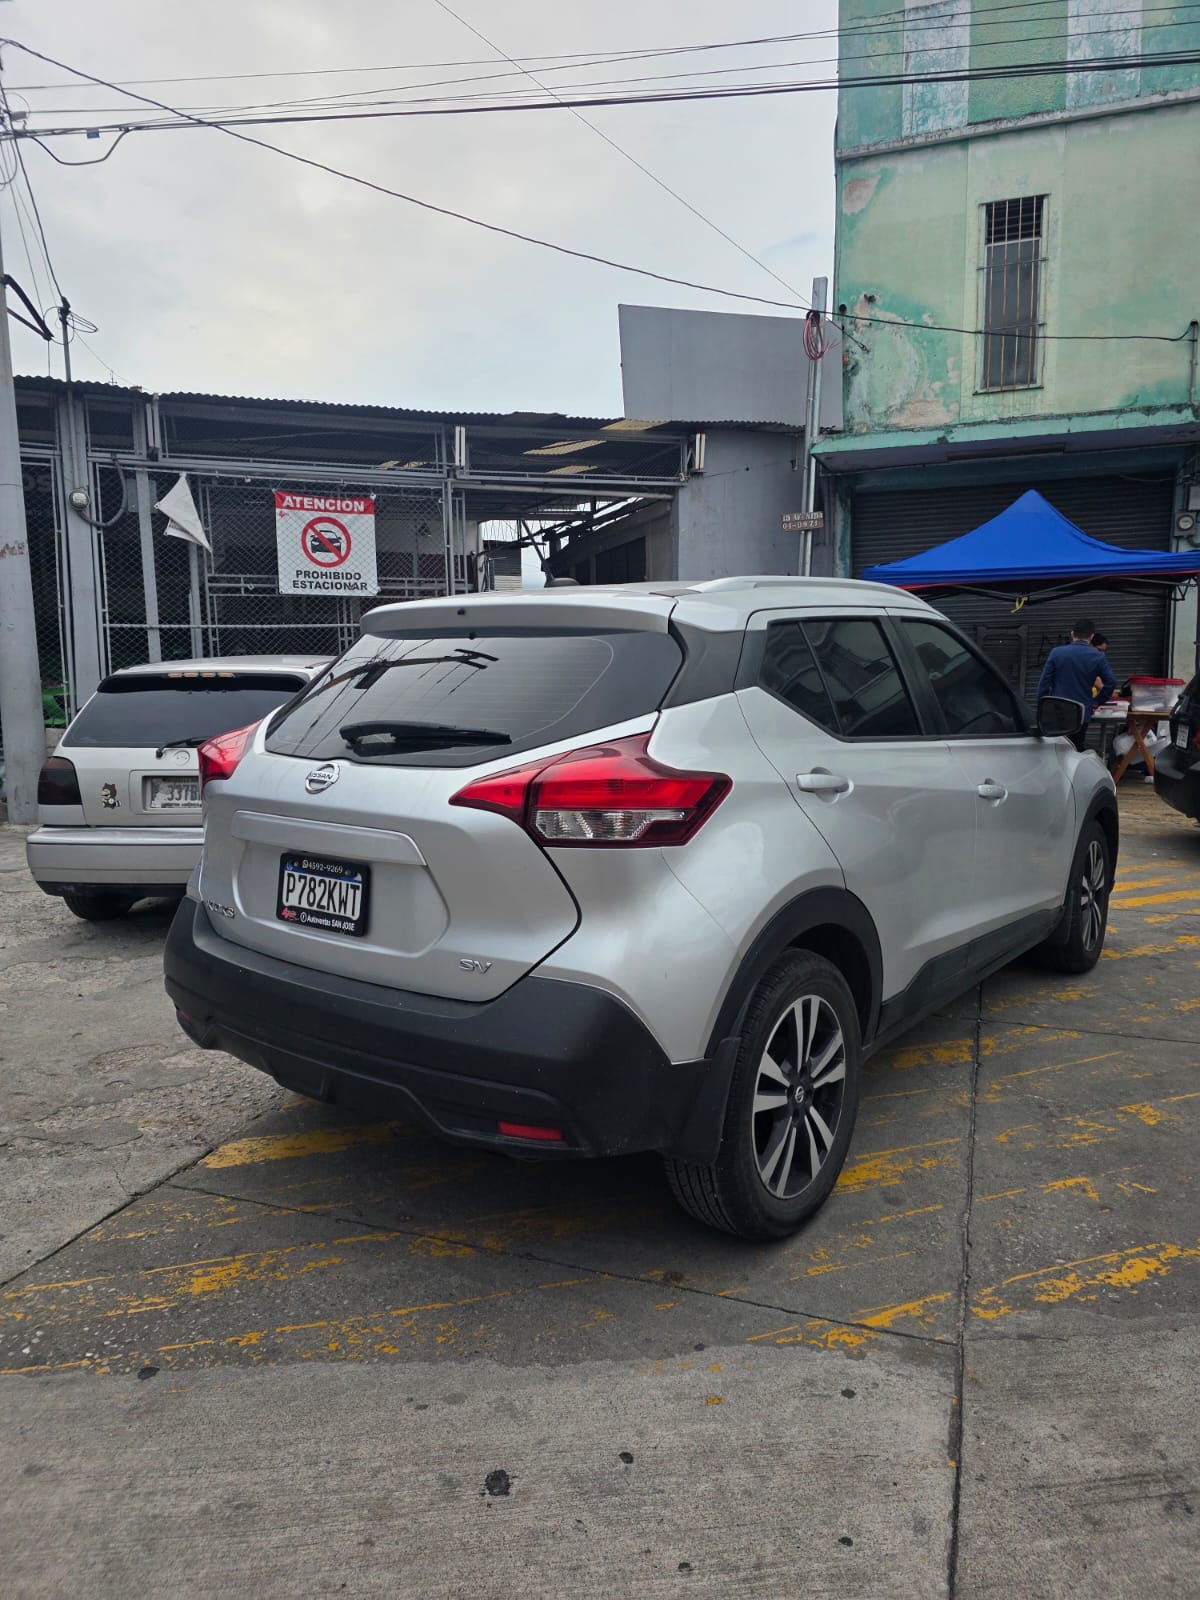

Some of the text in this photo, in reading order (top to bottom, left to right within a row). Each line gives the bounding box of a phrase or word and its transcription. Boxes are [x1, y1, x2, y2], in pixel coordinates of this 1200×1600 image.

[295, 570, 362, 581] PROHIBIDO
[292, 581, 368, 591] ESTACIONAR
[308, 861, 343, 874] 4592-9269
[285, 872, 361, 917] P782KWT
[331, 919, 342, 929] SAN
[458, 958, 492, 974] SV
